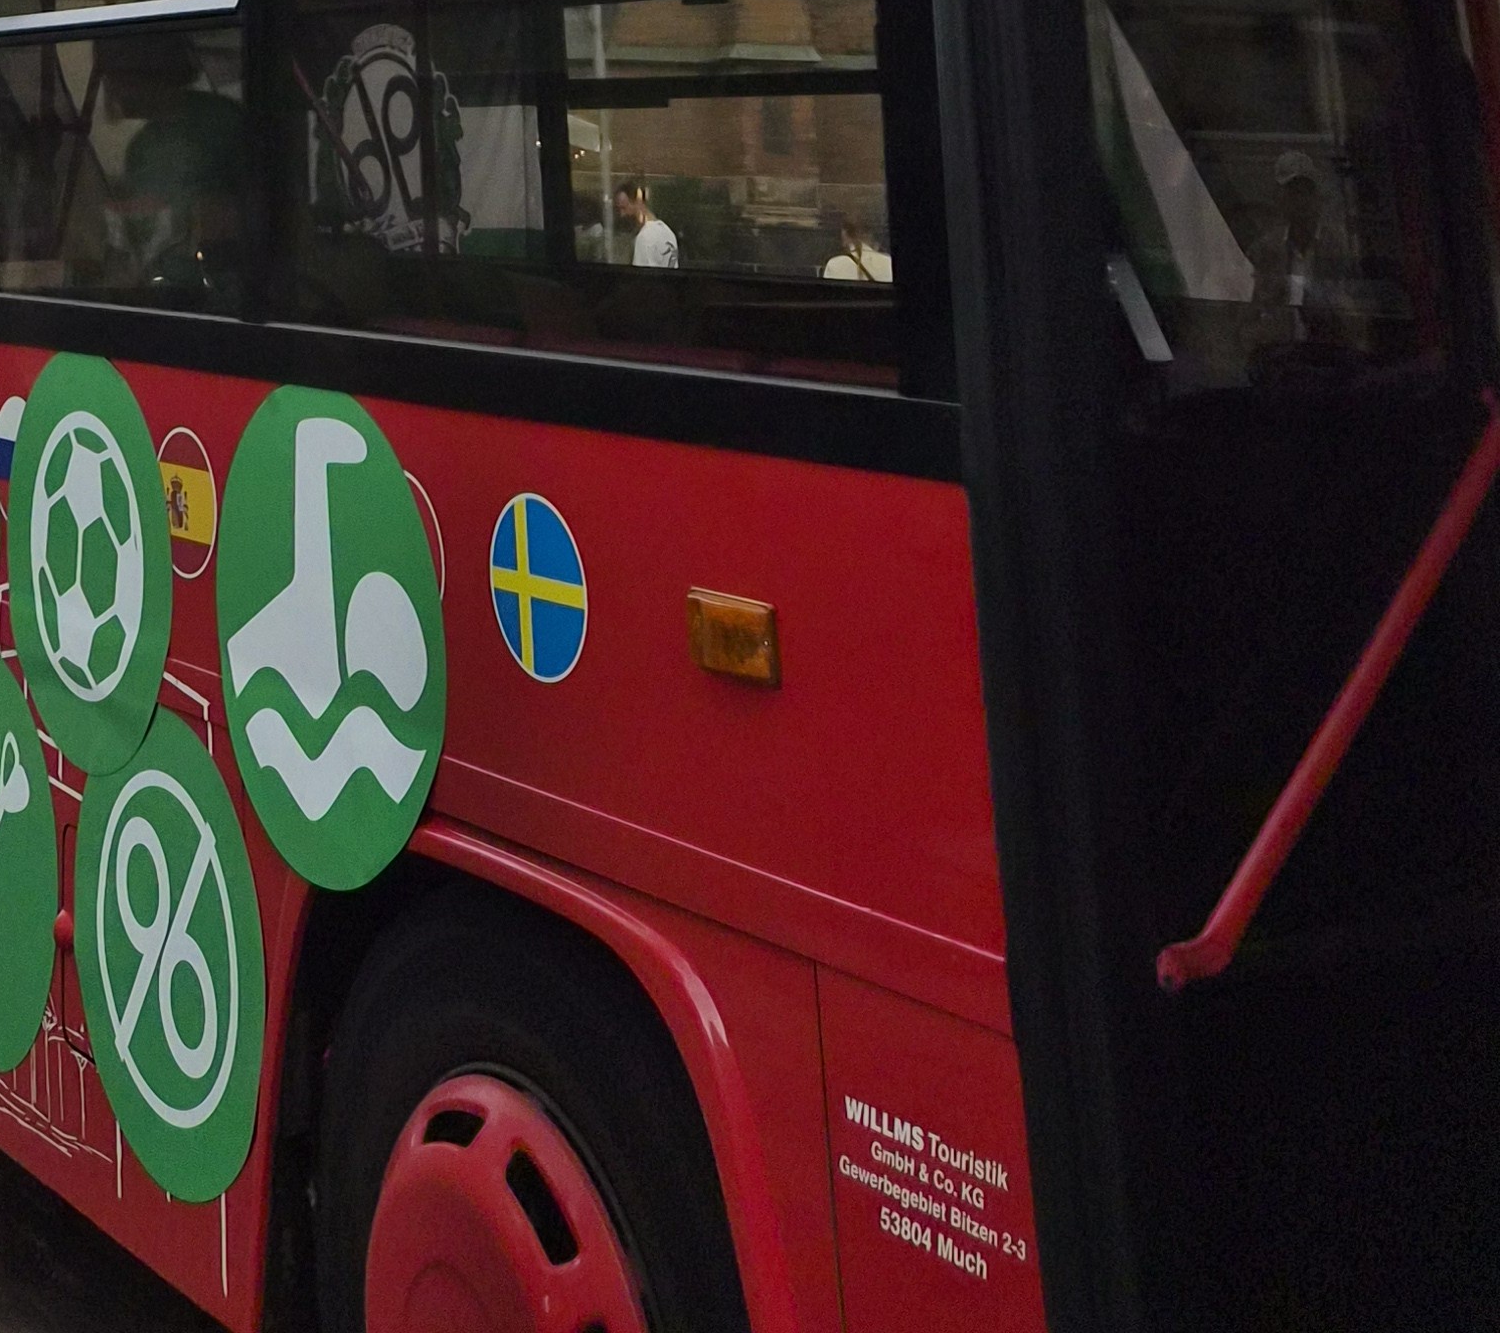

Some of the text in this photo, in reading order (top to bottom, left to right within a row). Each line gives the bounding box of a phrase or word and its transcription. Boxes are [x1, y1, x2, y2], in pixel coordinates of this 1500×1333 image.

[113, 814, 219, 1081] 96
[844, 1094, 1009, 1192] WILLMS Touristik
[870, 1140, 985, 1210] GmbH & Co. KG
[838, 1154, 1026, 1261] Gewerbegebiet Bitzen 2-3
[879, 1206, 988, 1280] 53804 Much
